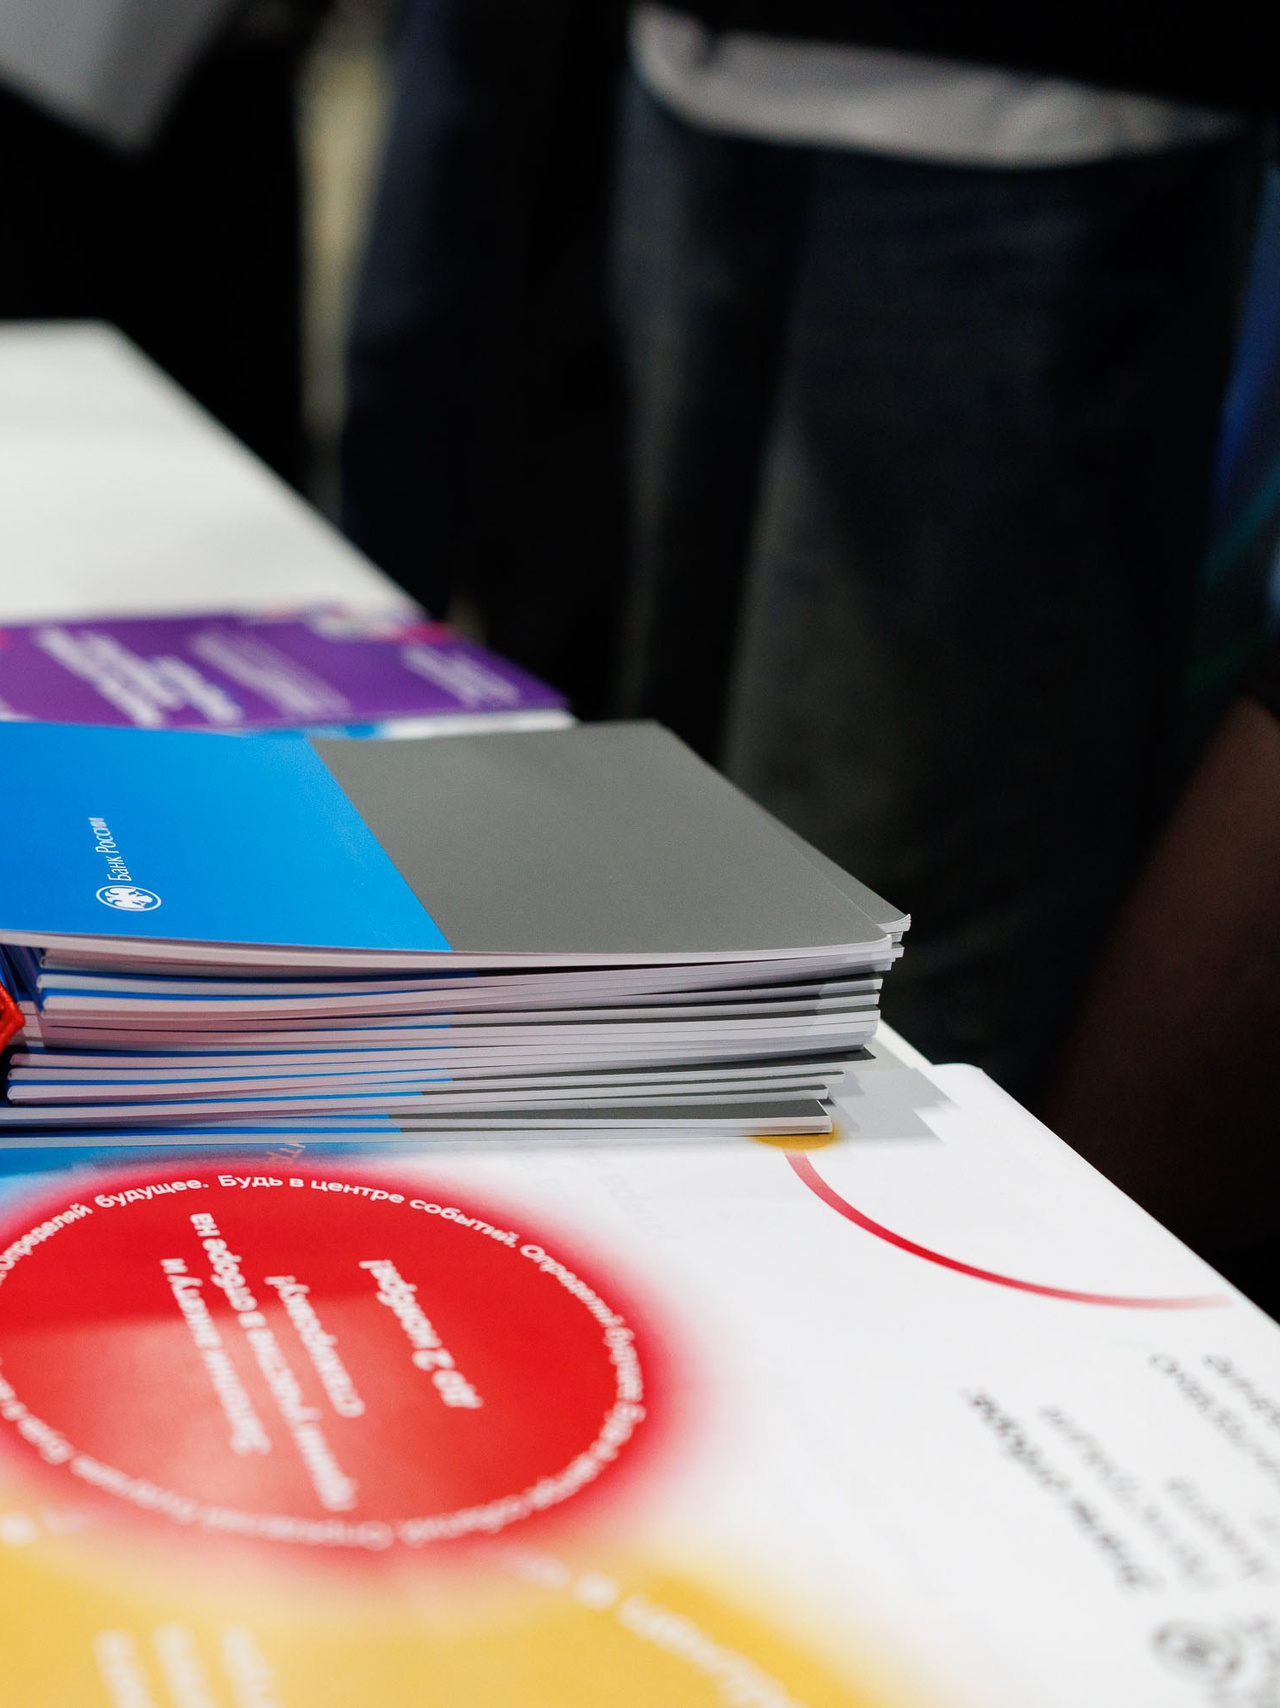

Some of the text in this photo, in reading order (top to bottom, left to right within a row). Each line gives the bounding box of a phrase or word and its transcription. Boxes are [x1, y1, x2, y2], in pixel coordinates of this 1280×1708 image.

[88, 816, 132, 882] Банк России
[94, 1178, 209, 1209] будущее.
[217, 1174, 284, 1189] Будь
[288, 1176, 305, 1188] в
[310, 1177, 406, 1204] центре
[408, 1197, 521, 1250] событий.
[189, 1212, 222, 1238] на
[160, 1257, 189, 1274] и
[200, 1238, 258, 1312] отборе
[410, 1348, 456, 1372] 2
